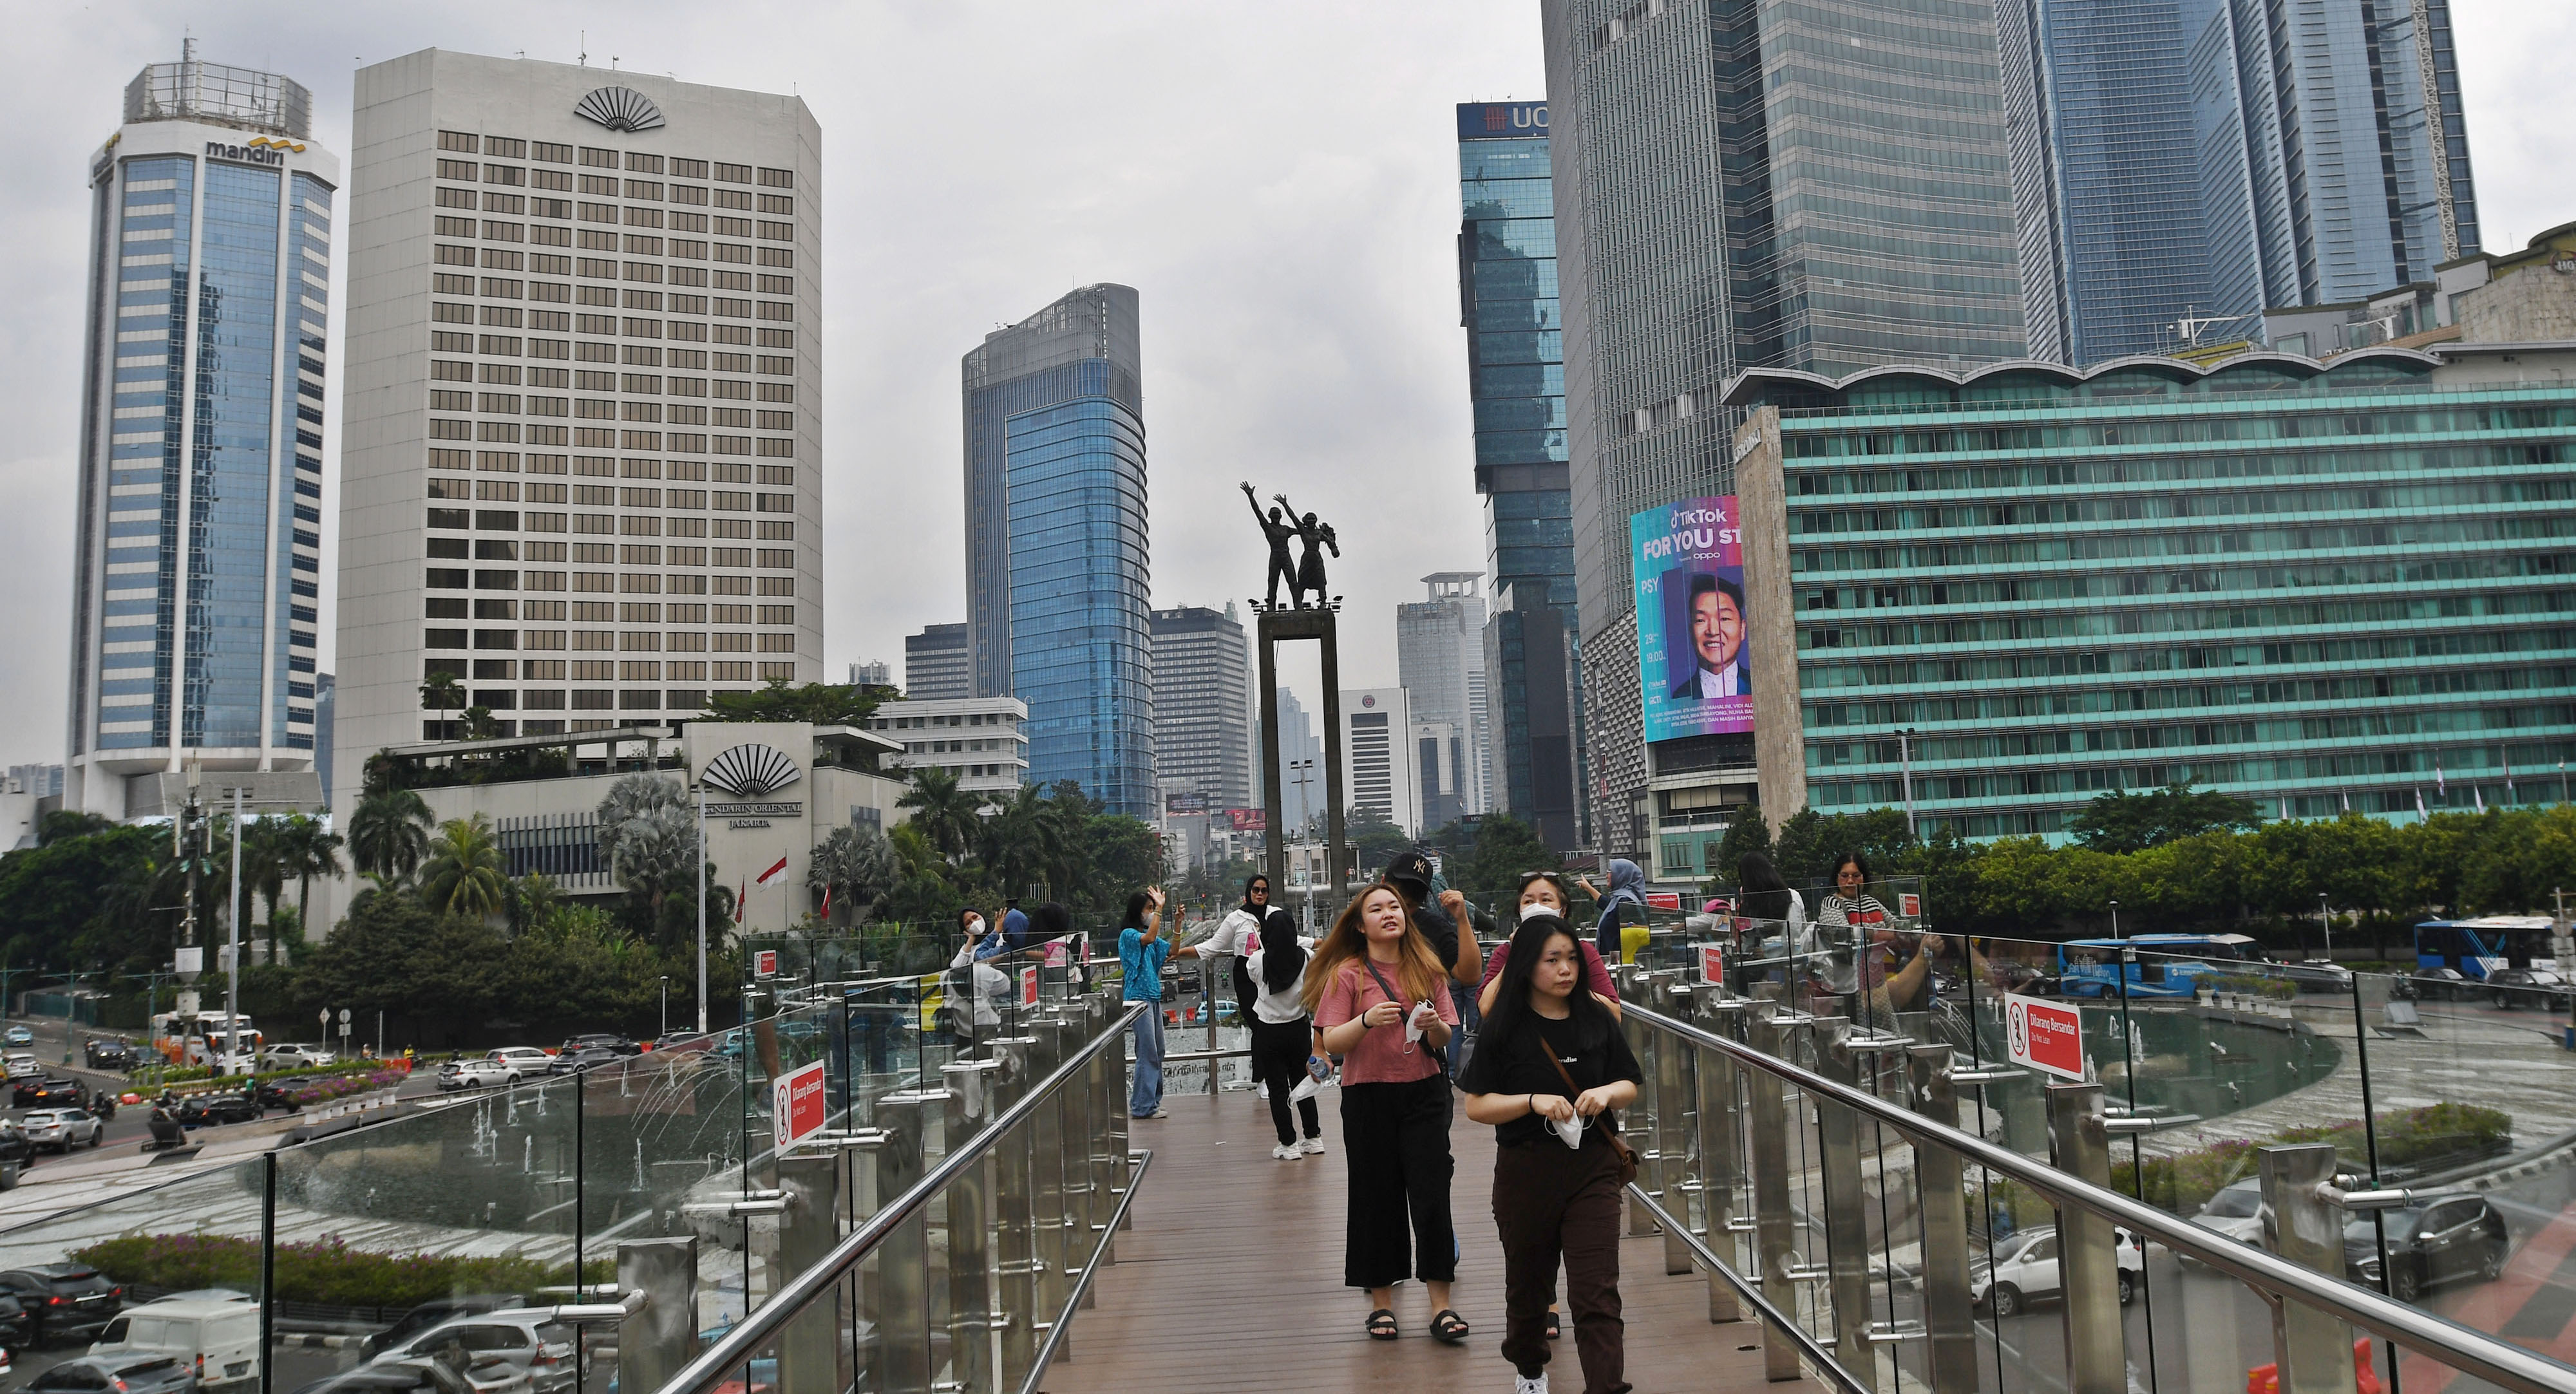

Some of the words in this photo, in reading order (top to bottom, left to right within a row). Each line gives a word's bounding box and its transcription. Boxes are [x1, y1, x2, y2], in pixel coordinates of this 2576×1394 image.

[206, 141, 284, 165] mandiri
[2557, 260, 2576, 271] HO
[1678, 508, 1727, 526] TikTok
[1643, 536, 1672, 561] FOR
[1672, 528, 1714, 552] YOU
[1693, 552, 1721, 560] oppo
[1642, 576, 1660, 595] PSY
[705, 804, 752, 813] ANDARIN
[755, 804, 802, 813] ORIENTAL
[729, 818, 771, 829] JAKARTA
[2030, 1013, 2050, 1033] Dilarang
[2050, 1017, 2075, 1035] Bersandar
